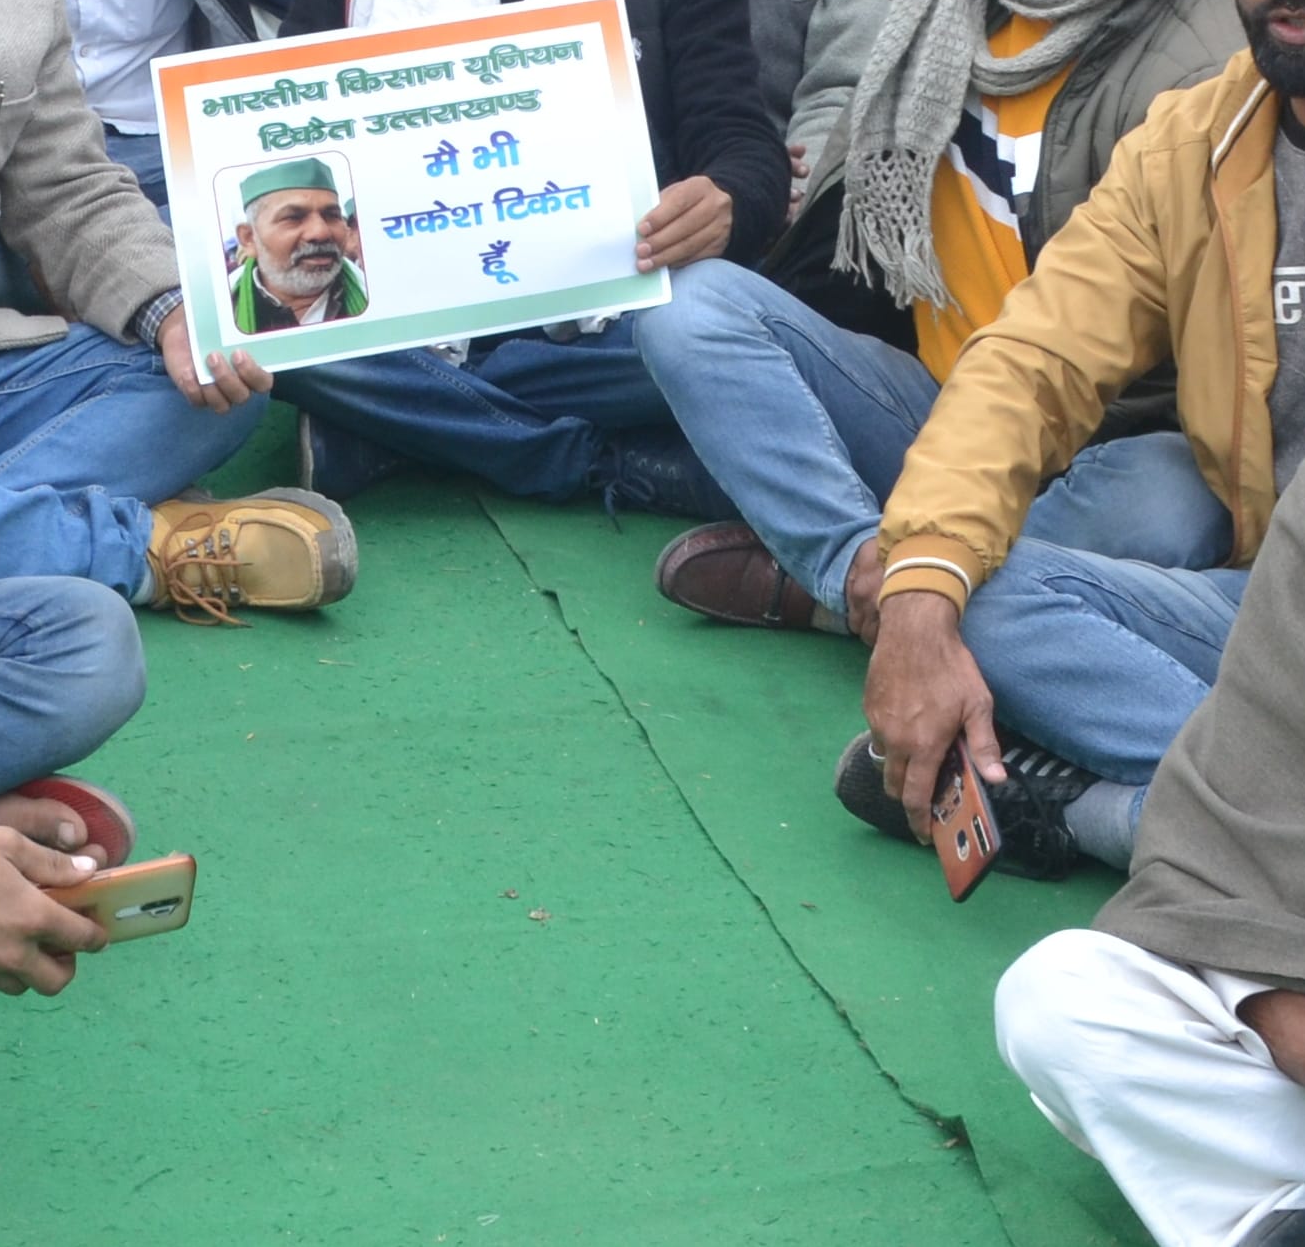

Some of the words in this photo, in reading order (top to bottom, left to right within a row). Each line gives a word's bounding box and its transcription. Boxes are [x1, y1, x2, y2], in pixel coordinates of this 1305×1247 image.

[202, 79, 328, 118] भारतीय
[336, 60, 454, 97] किसान
[462, 39, 584, 83] यूनियन
[472, 130, 521, 169] भी
[380, 200, 483, 240] राकेश
[492, 180, 592, 222] टिकैत
